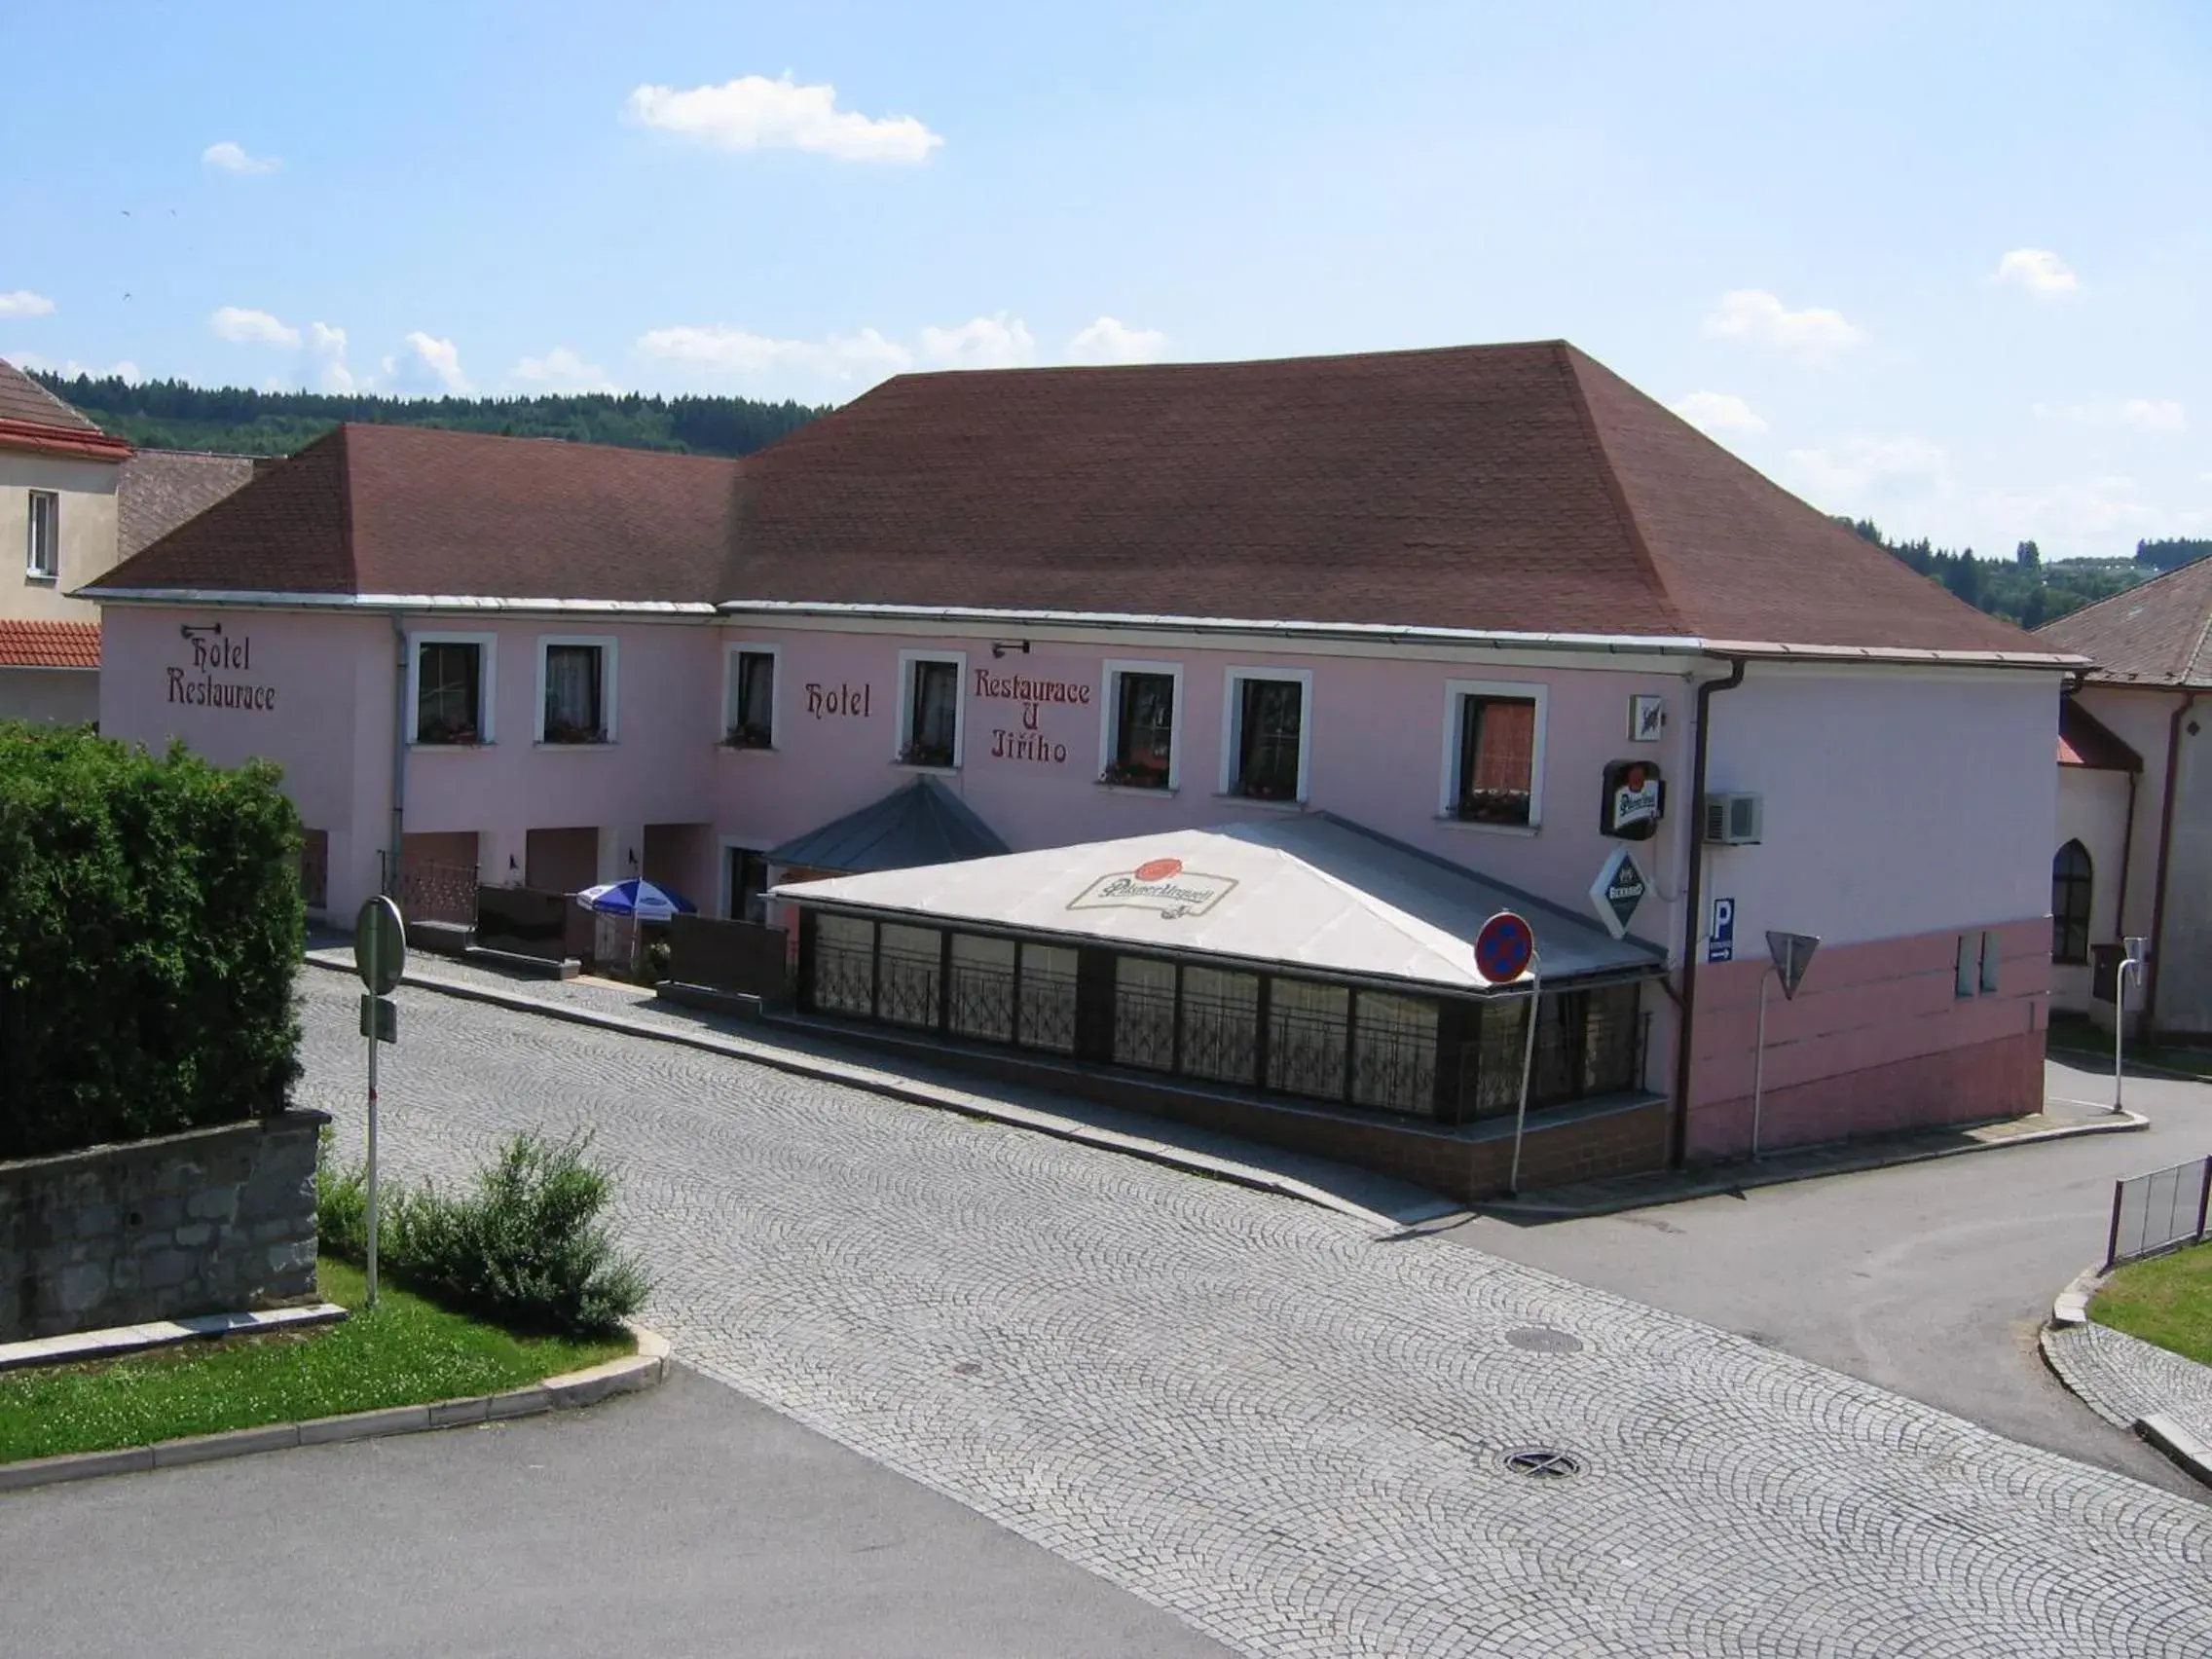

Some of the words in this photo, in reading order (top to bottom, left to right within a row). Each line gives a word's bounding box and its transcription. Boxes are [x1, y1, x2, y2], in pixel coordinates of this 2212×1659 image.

[166, 667, 276, 711] Restaurace
[976, 669, 1089, 704] Restaurace
[991, 729, 1068, 764] Jiřího
[1714, 901, 1731, 940] P
